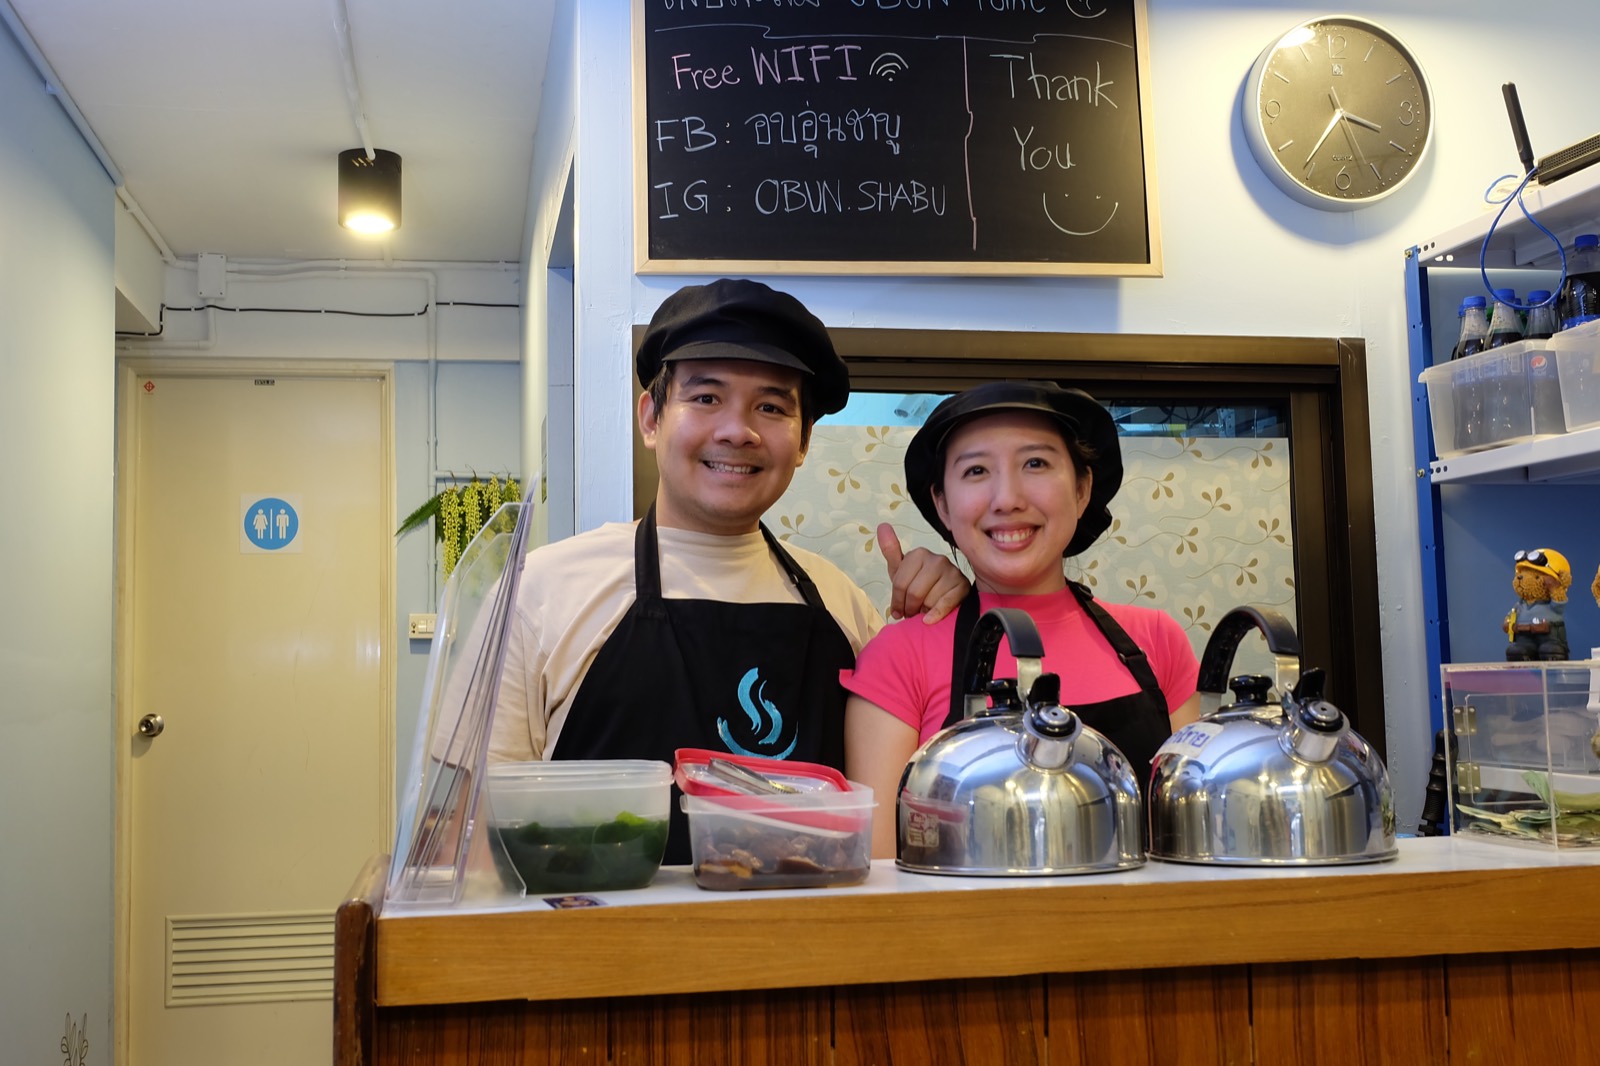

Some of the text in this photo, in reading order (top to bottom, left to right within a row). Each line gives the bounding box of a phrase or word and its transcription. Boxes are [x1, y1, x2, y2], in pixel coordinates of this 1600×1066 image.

[1325, 34, 1347, 60] 12
[671, 44, 862, 91] Free WIFI
[989, 51, 1118, 109] Thank
[1264, 100, 1281, 125] 9
[1398, 100, 1415, 126] 3
[1012, 125, 1077, 172] You
[1334, 165, 1351, 191] 6
